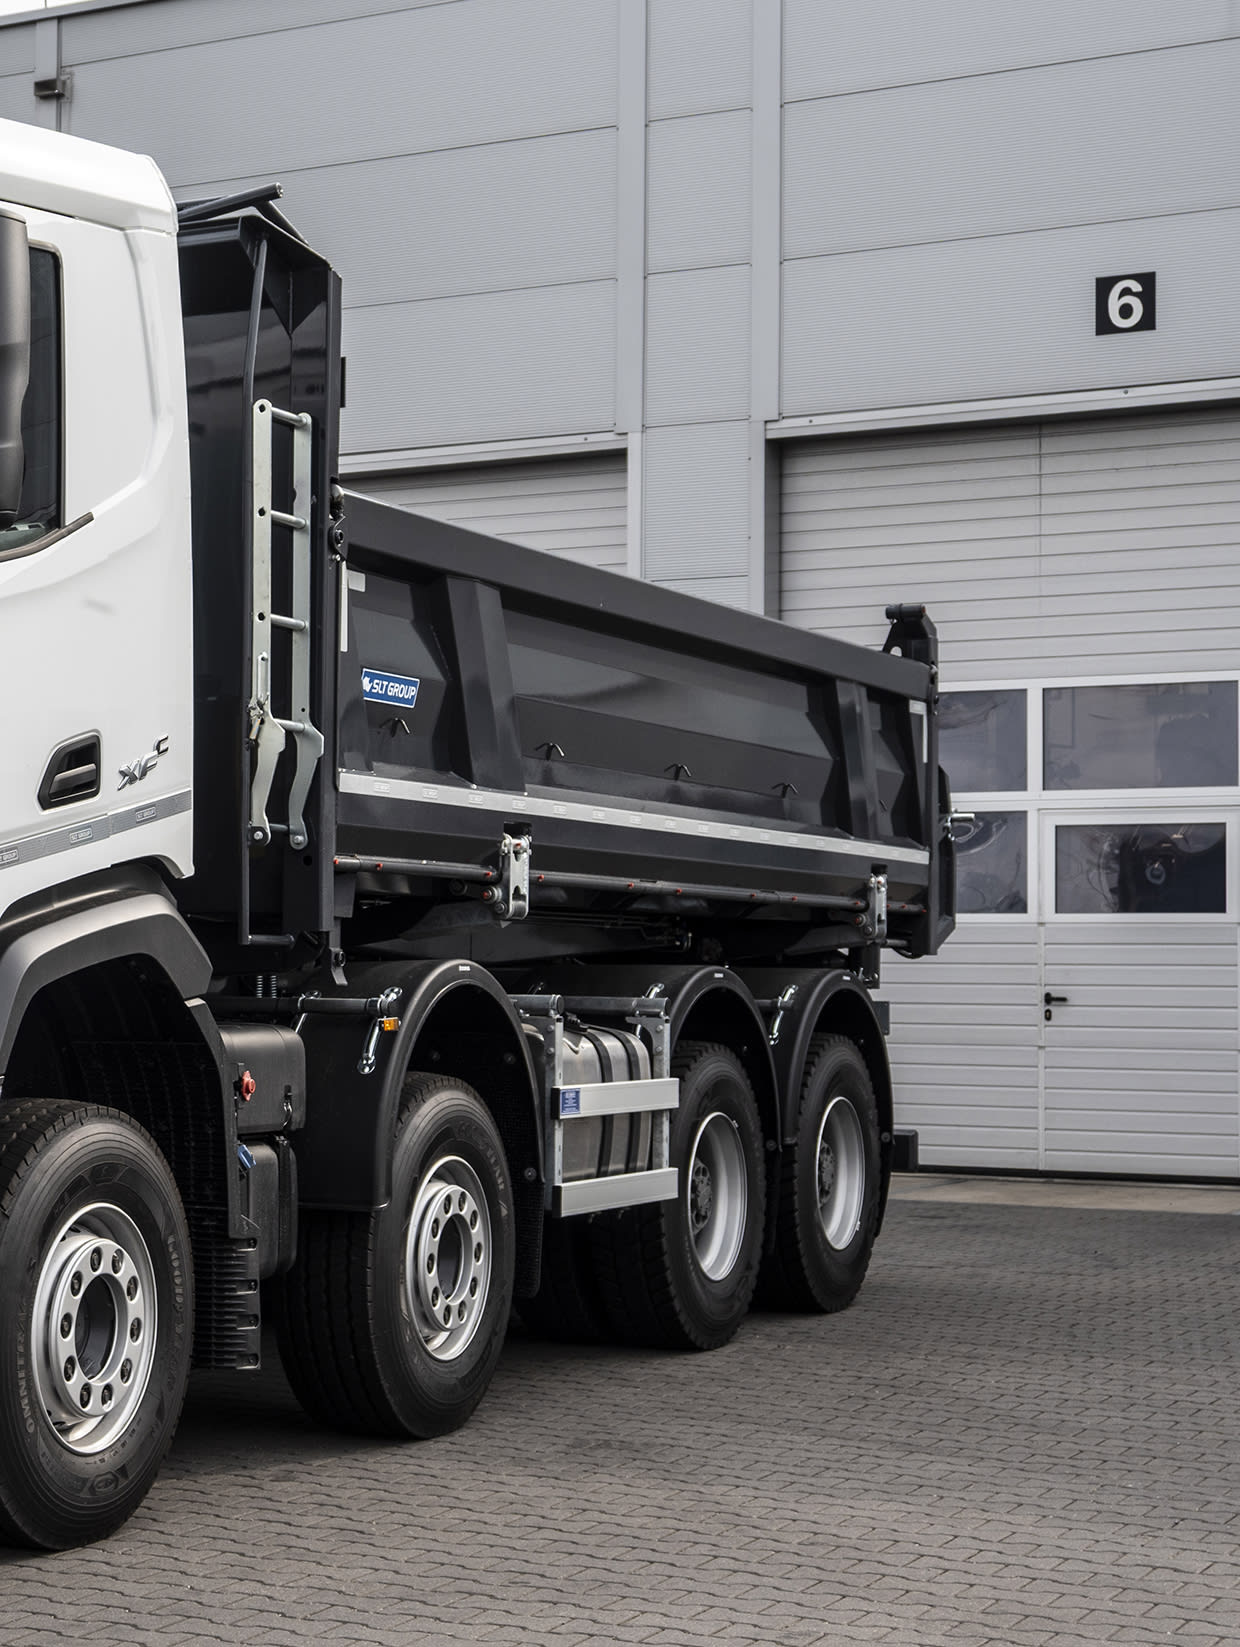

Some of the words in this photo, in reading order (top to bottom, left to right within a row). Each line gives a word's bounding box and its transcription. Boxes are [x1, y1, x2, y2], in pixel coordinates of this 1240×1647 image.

[1108, 279, 1143, 328] 6
[372, 679, 388, 694] SLT
[387, 682, 416, 699] GROUP
